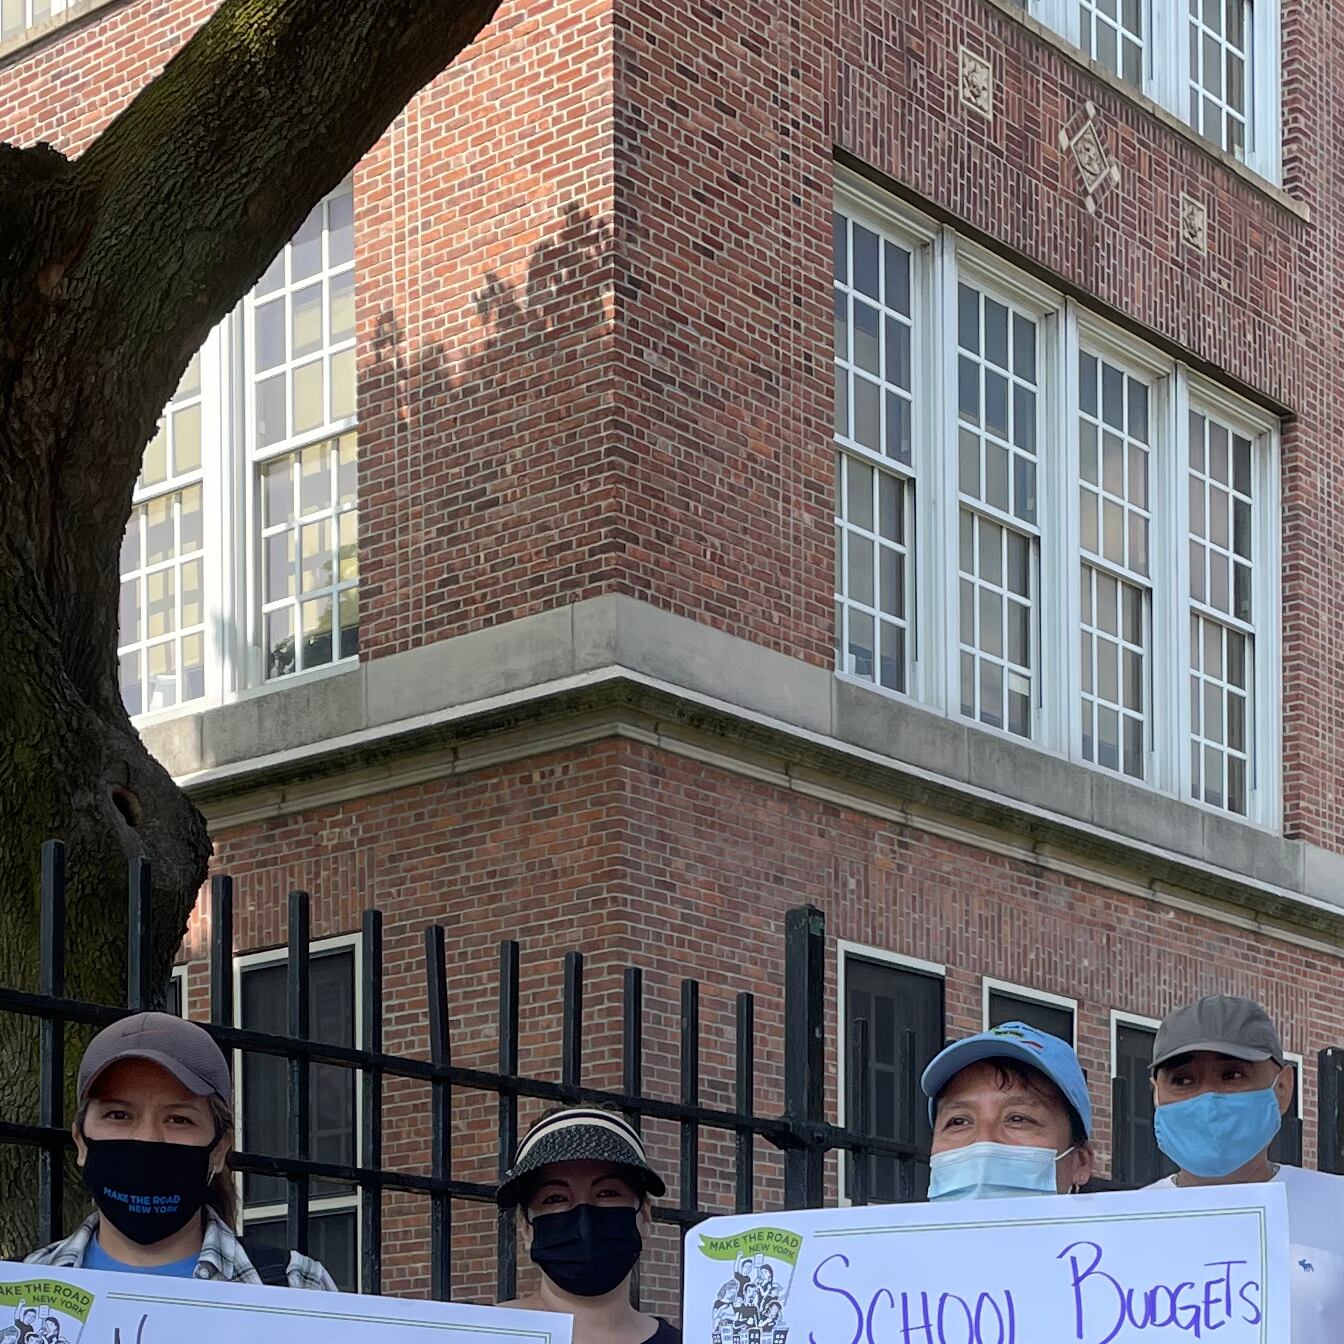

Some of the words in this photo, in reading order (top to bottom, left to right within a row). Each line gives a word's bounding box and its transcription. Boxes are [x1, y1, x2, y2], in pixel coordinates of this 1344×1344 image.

[103, 1186, 129, 1203] MAKE
[130, 1195, 151, 1205] THE
[152, 1194, 181, 1205] ROAD
[128, 1204, 152, 1214] NEW
[709, 1237, 740, 1251] MAKE
[741, 1232, 765, 1245] THE
[766, 1231, 799, 1248] ROAD
[749, 1244, 770, 1253] NEW
[772, 1244, 796, 1259] YORK
[24, 1283, 51, 1293] THE
[53, 1284, 90, 1306] ROAD
[32, 1295, 58, 1304] NEW
[60, 1299, 85, 1316] YORK
